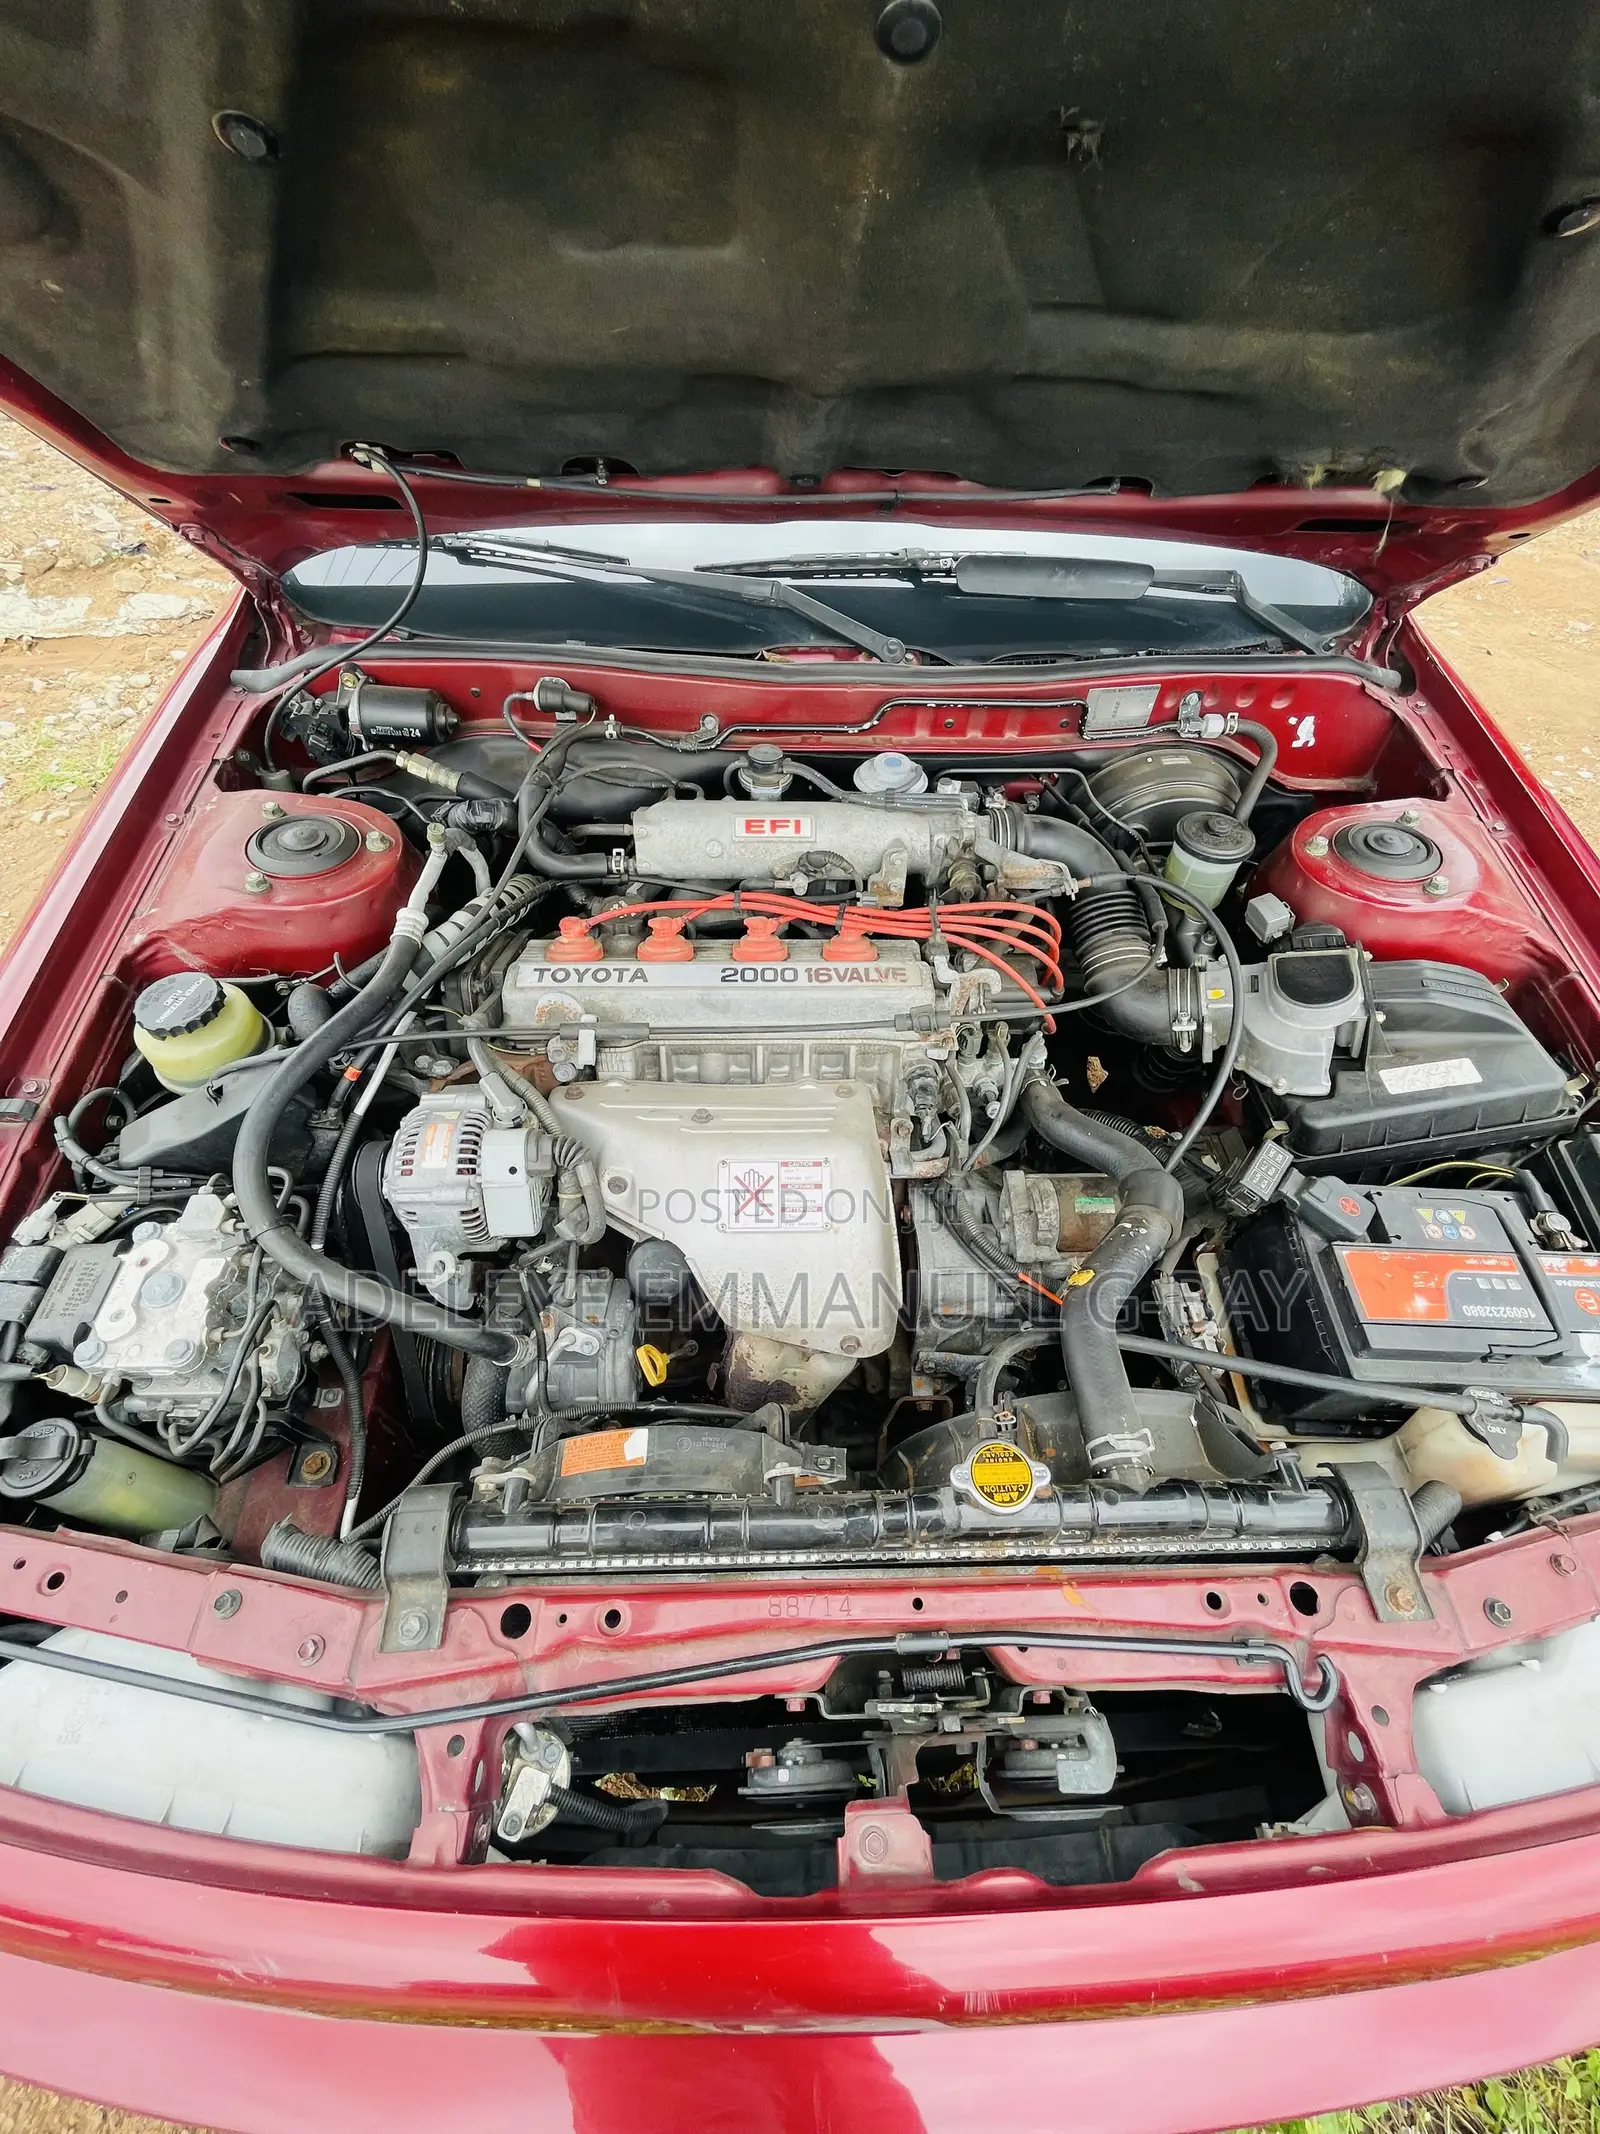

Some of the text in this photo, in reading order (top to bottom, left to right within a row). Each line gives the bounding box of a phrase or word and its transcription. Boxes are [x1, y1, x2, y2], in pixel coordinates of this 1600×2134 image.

[410, 728, 421, 737] 24
[744, 819, 802, 835] EFI
[533, 967, 649, 984] TOYOTA
[720, 967, 799, 984] 2000
[163, 989, 183, 1007] FLUID
[1463, 1304, 1536, 1319] 1609232880
[1487, 1425, 1507, 1435] ONLY
[983, 1485, 1025, 1493] CAUTION
[767, 1593, 853, 1618] 88714
